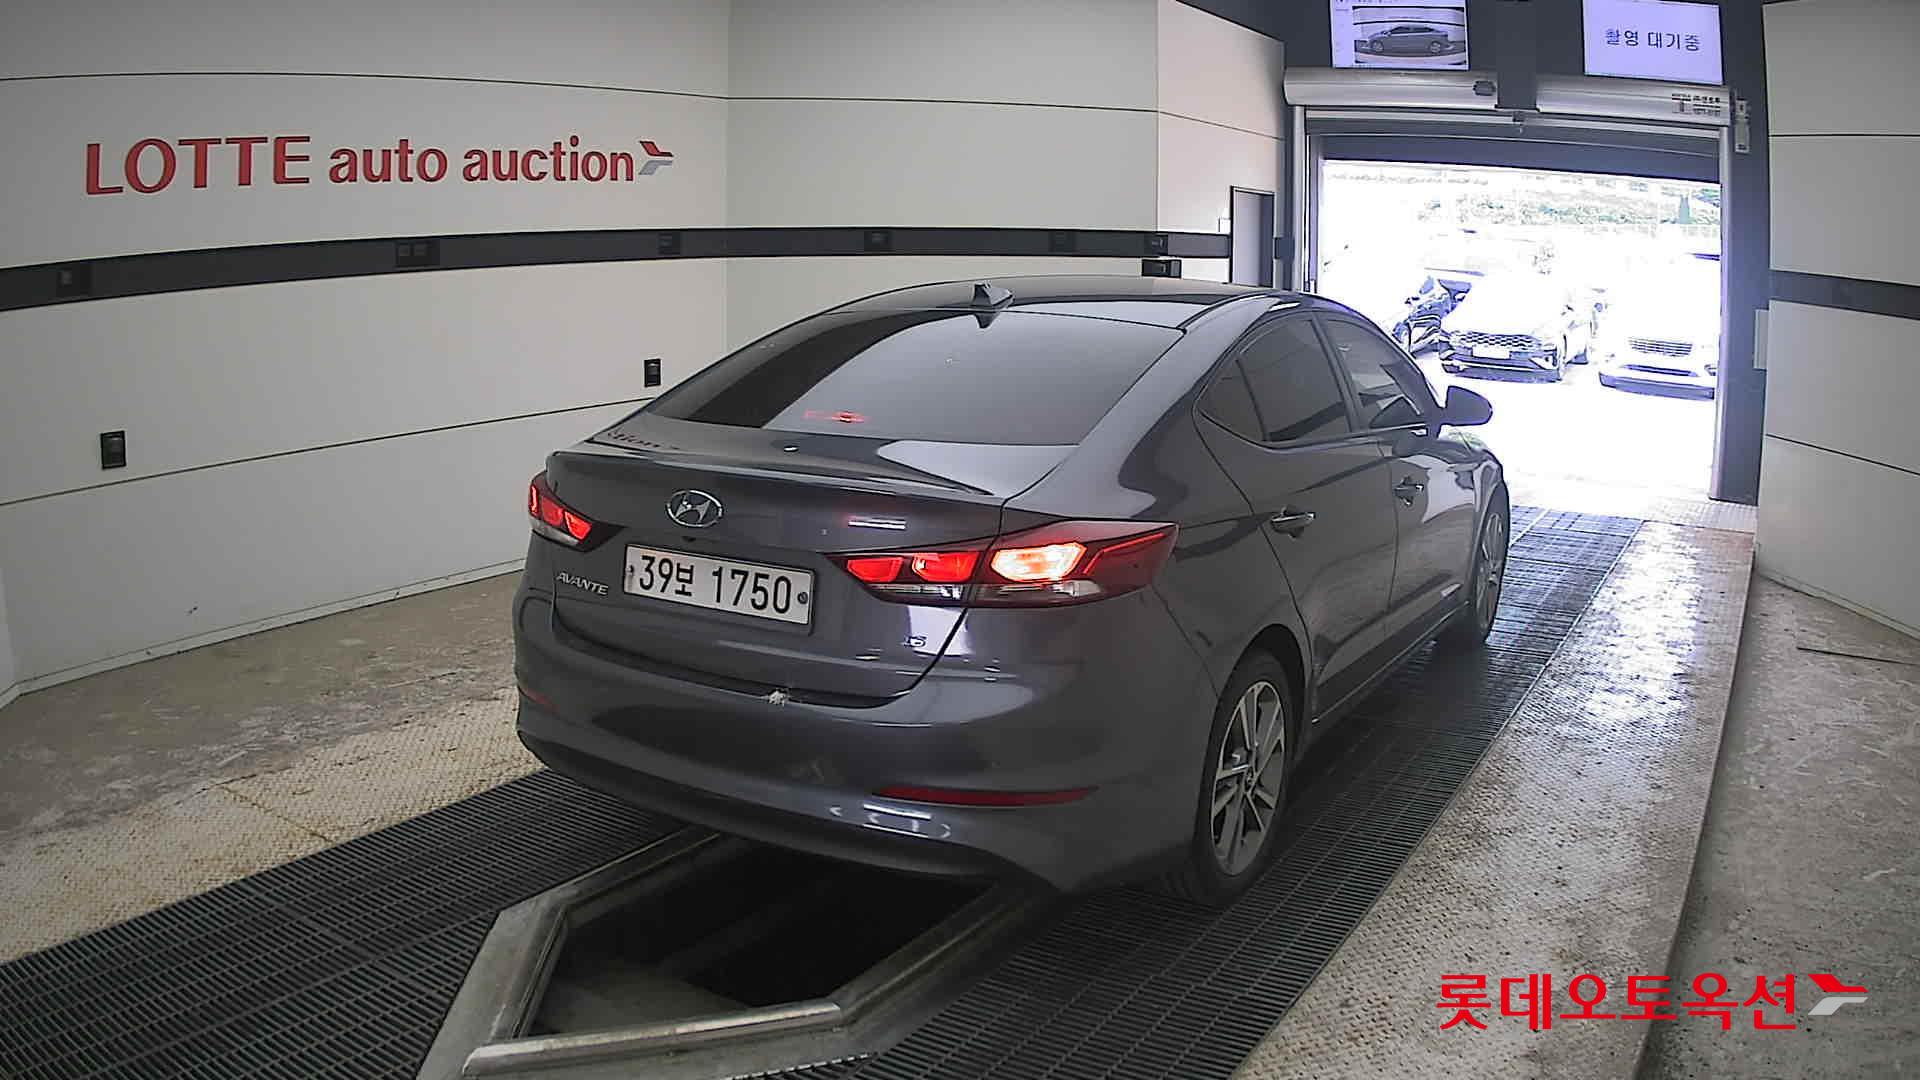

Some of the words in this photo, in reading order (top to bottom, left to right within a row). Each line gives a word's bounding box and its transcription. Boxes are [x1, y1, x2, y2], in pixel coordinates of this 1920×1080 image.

[1647, 31, 1701, 52] 대기중
[86, 135, 311, 195] LOTTE
[328, 138, 448, 184] auto
[462, 135, 635, 182] auction
[556, 572, 609, 596] AVANTE
[639, 554, 695, 597] 39보
[711, 566, 792, 615] 1750
